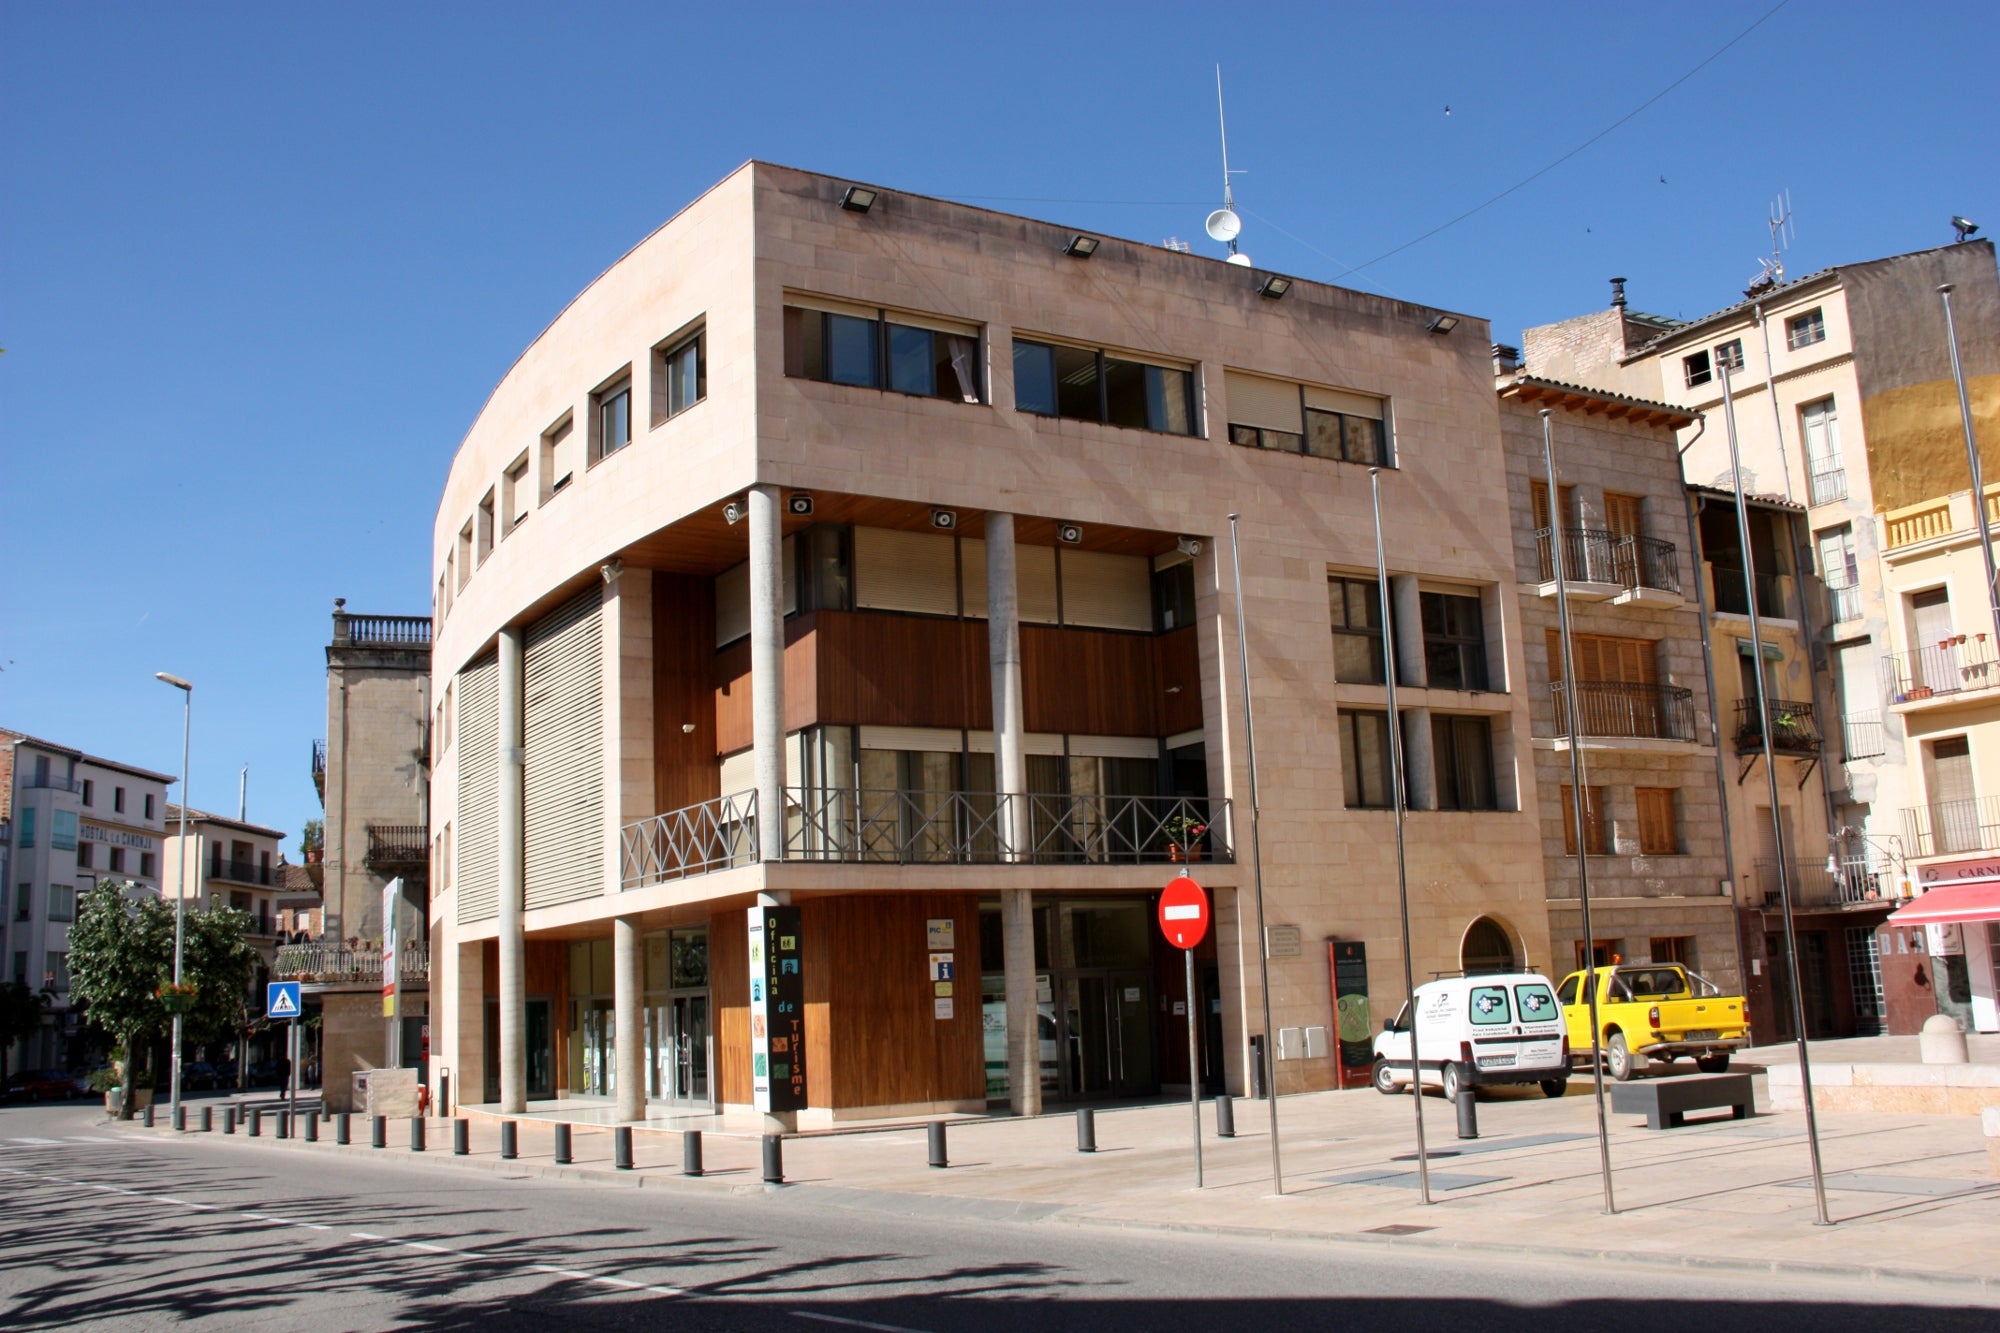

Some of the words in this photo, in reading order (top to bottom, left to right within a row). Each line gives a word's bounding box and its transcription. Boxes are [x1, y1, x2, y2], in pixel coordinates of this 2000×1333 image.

[80, 825, 108, 842] HOSTAL
[1880, 931, 1925, 955] BAR
[769, 918, 778, 995] Oficina
[778, 1001, 793, 1013] de
[790, 1019, 803, 1095] Turisme
